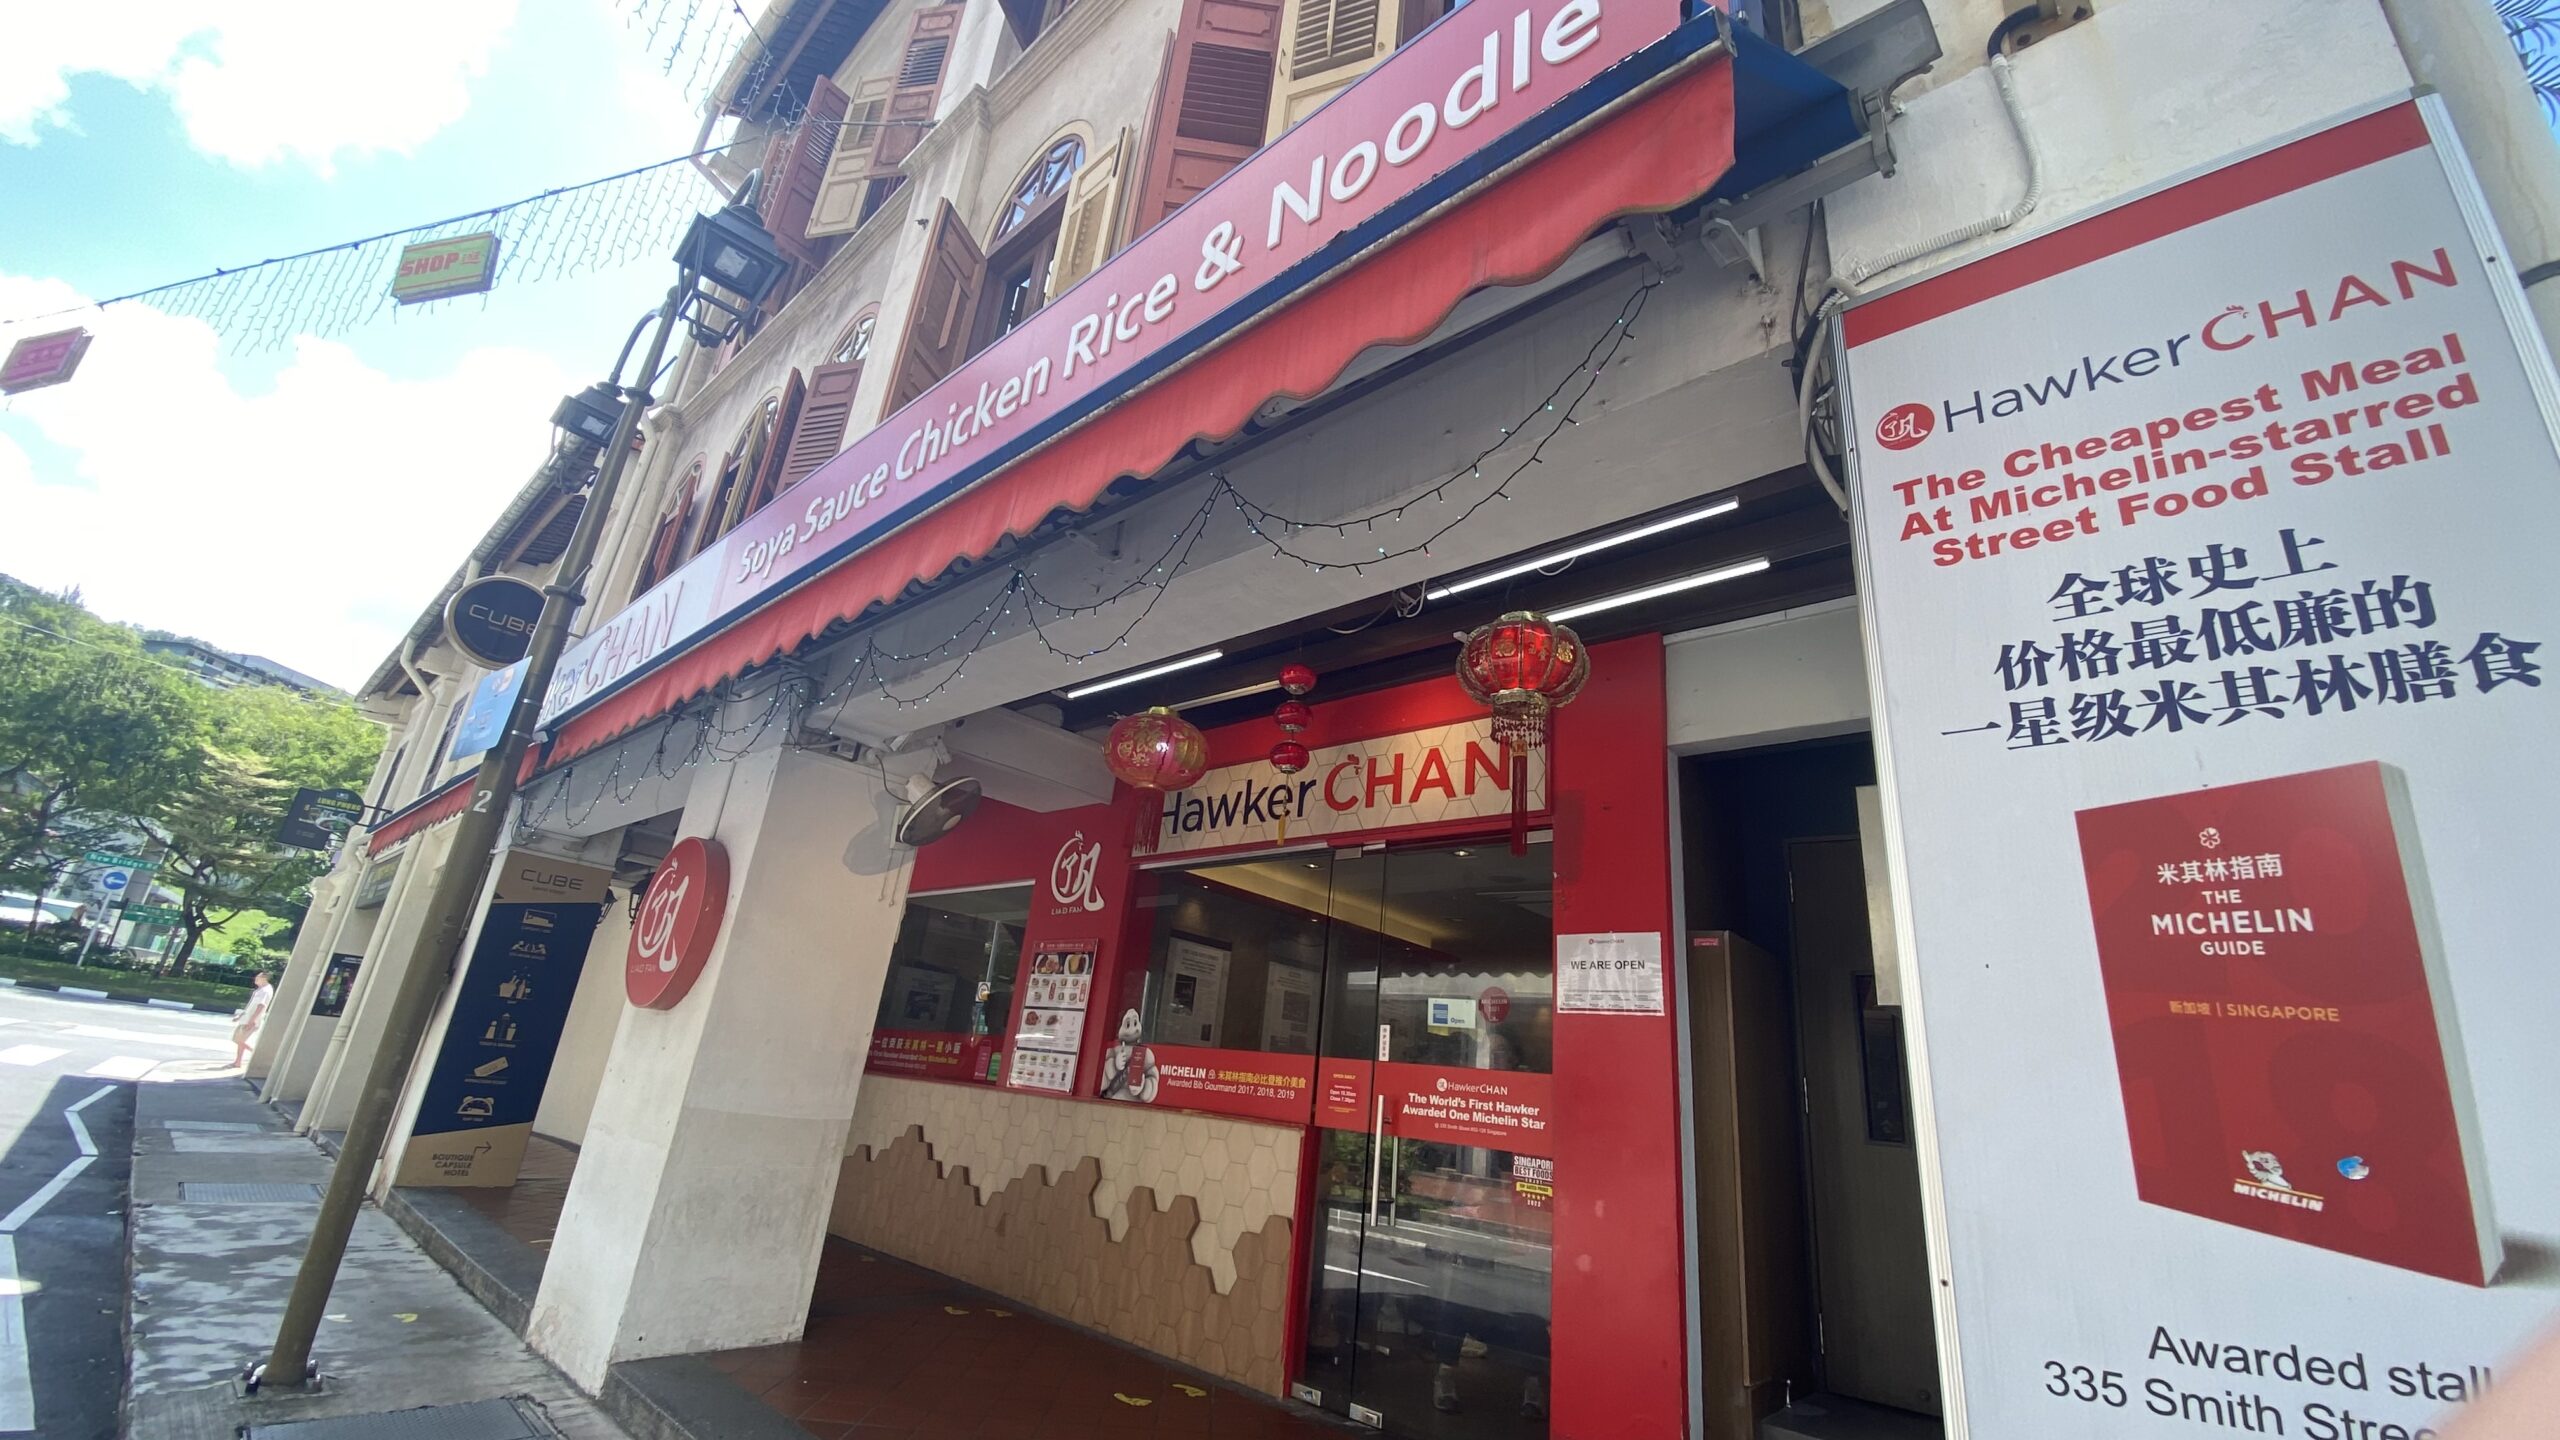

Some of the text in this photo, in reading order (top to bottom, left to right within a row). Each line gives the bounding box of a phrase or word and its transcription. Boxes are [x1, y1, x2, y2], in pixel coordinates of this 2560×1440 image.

[399, 252, 460, 277] SHOP
[737, 0, 1602, 583] Soya Sauce Chicken Rice & Noodle
[1892, 332, 2467, 508] The Cheapest Meal
[1899, 372, 2481, 542] At Michelin-starred
[1932, 424, 2451, 567] Street Food Stall
[2046, 528, 2339, 624] 全球史上
[1994, 574, 2439, 692] 价格最低廉的
[1941, 631, 2543, 751] 一星级米其林膳食
[473, 790, 492, 813] 2
[520, 868, 585, 891] CUBE
[2157, 853, 2284, 886] 米其林指南
[2201, 889, 2242, 905] THE
[1069, 906, 1083, 914] FAN
[2151, 908, 2315, 936] MICHELIN
[2200, 940, 2267, 956] GUIDE
[1571, 960, 1646, 970] WE ARE OPEN
[2169, 1001, 2341, 1022] 新加坡 SINGAPORE
[1160, 1064, 1206, 1079] MICHELIN
[1167, 1077, 1295, 1100] Awarded Bib Gourmand 2017, 2018, 2019
[1408, 1092, 1540, 1116] The World's First Hawker
[1402, 1105, 1546, 1130] Awarded One Michelin Star
[432, 1153, 474, 1162] BOUTIQUE
[435, 1161, 472, 1169] CAPSULE
[443, 1169, 469, 1177] HOTEL
[1515, 1166, 1531, 1176] BEST
[2233, 1183, 2324, 1212] MICHELIN
[2148, 1325, 2492, 1404] Awarded stall
[2043, 1361, 2129, 1408] 335
[2144, 1378, 2285, 1437] Smith
